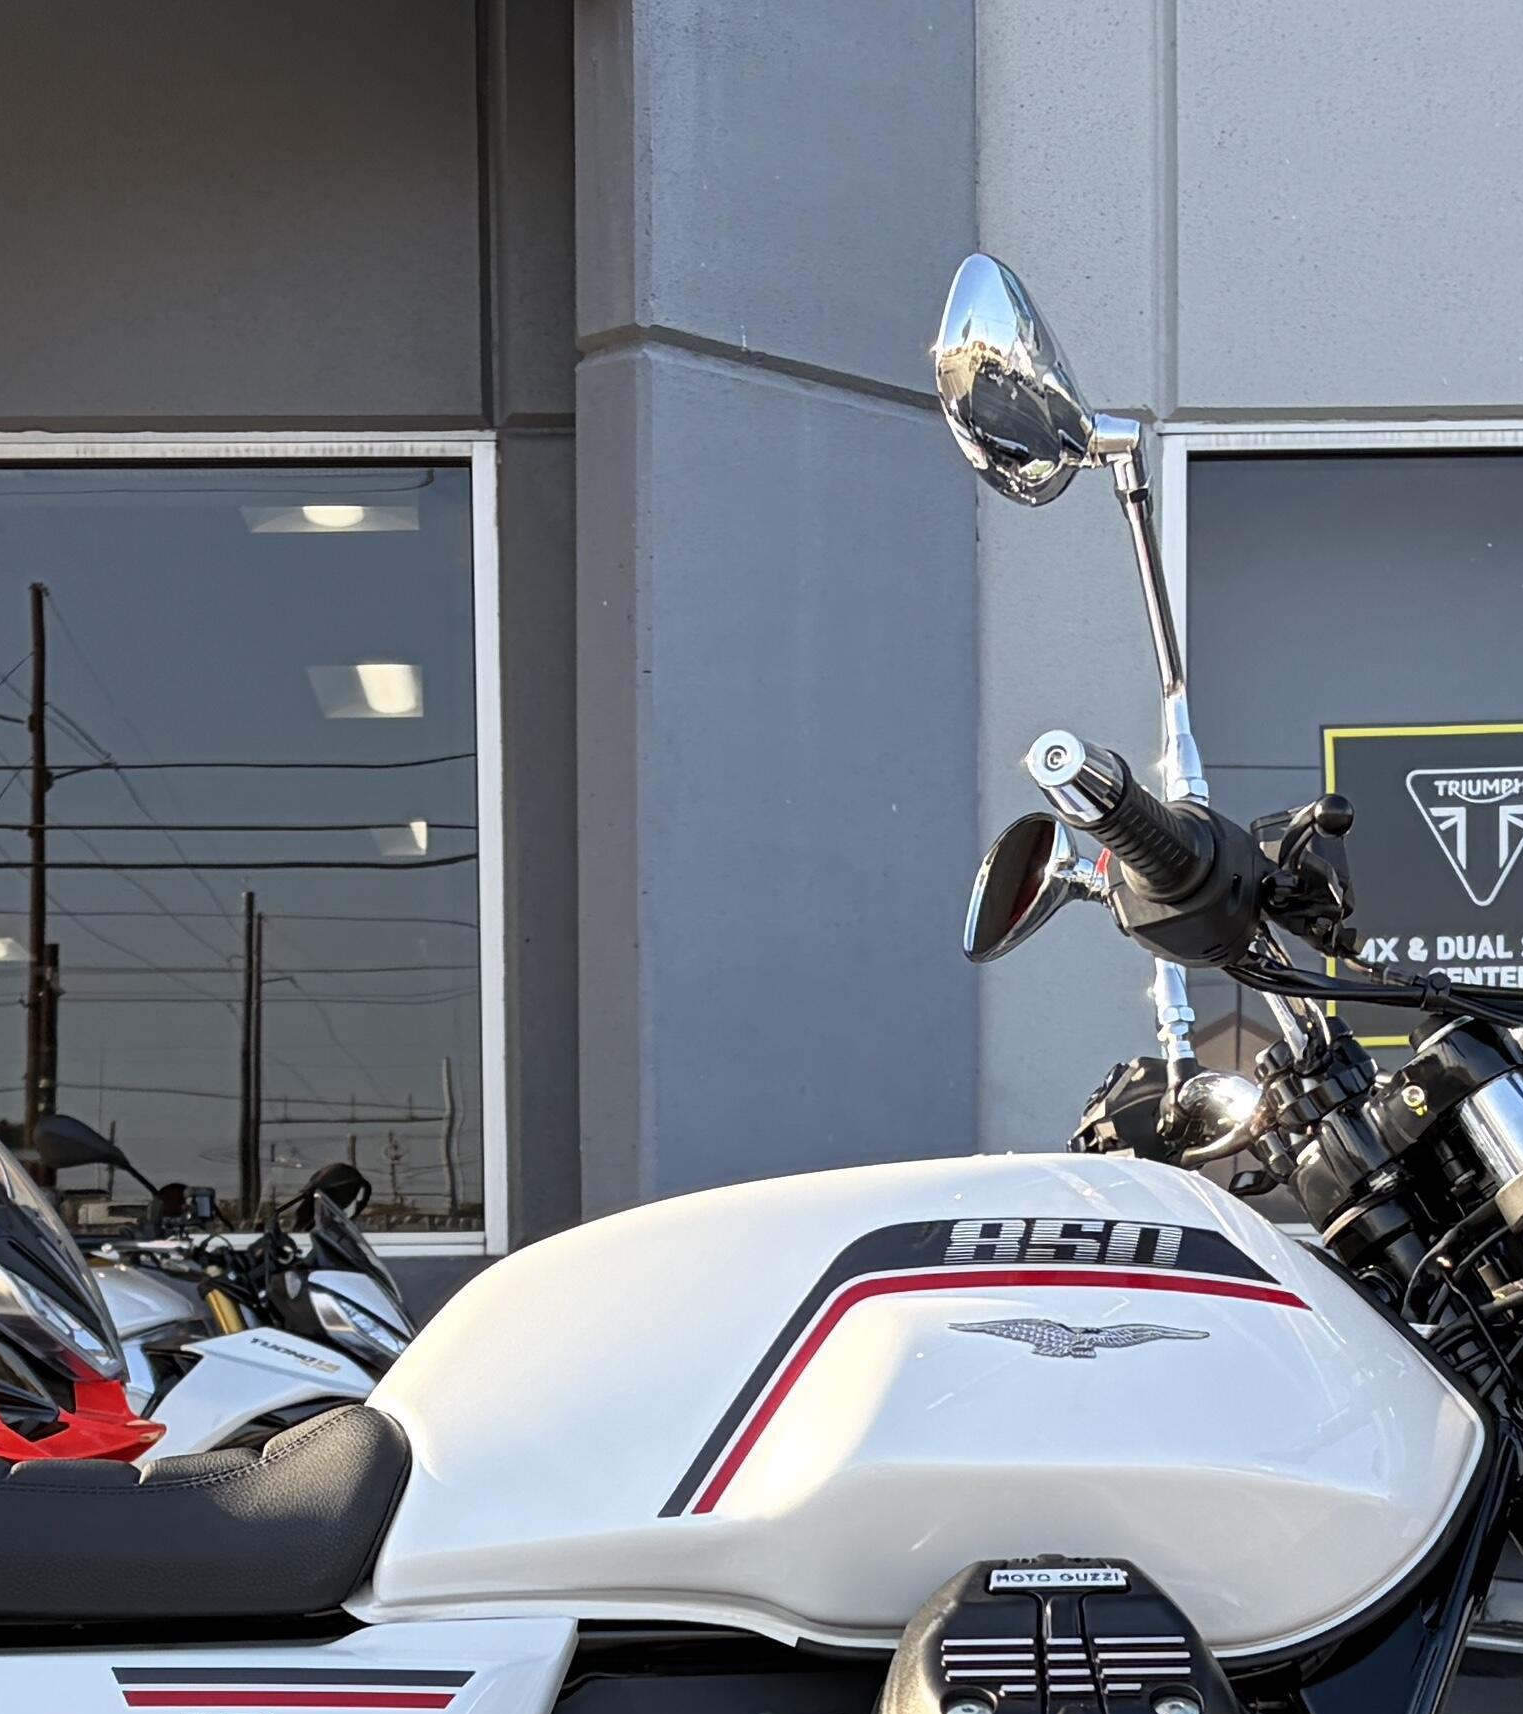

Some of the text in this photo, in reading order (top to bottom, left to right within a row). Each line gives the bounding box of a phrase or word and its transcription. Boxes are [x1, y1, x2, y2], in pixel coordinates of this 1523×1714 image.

[1407, 936, 1428, 962] &
[1436, 934, 1513, 960] DUAL
[943, 1218, 1184, 1267] 850
[995, 1571, 1123, 1584] MOTO GUZZI
